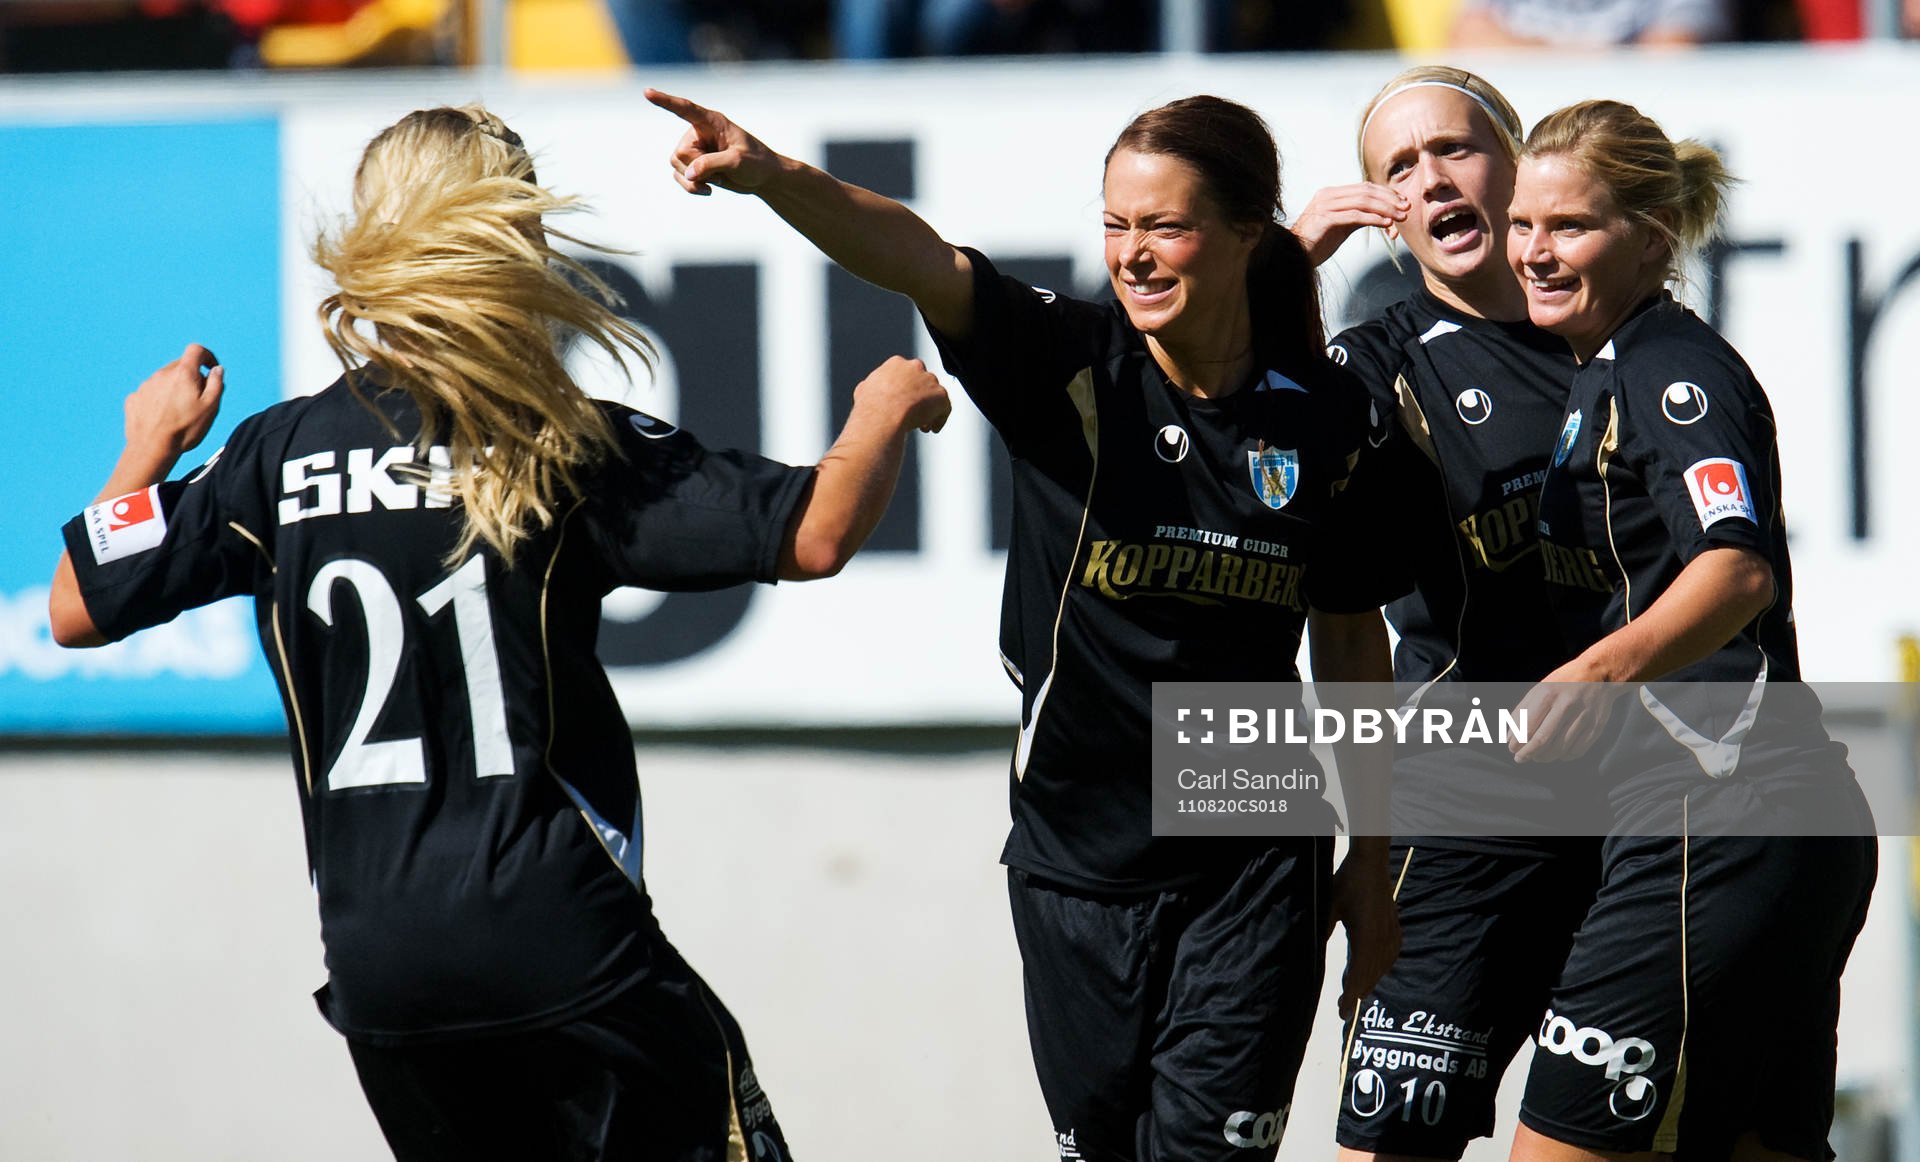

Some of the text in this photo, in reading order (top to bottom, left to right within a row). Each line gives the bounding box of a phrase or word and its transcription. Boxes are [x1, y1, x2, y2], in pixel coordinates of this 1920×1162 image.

[1154, 525, 1289, 558] PREMIUM CIDER
[1080, 539, 1306, 612] KOPPARBER
[307, 552, 516, 791] 21
[1361, 999, 1494, 1045] Åke Ekstrand
[1351, 1039, 1489, 1080] Byggnads AB
[1400, 1076, 1447, 1127] 10
